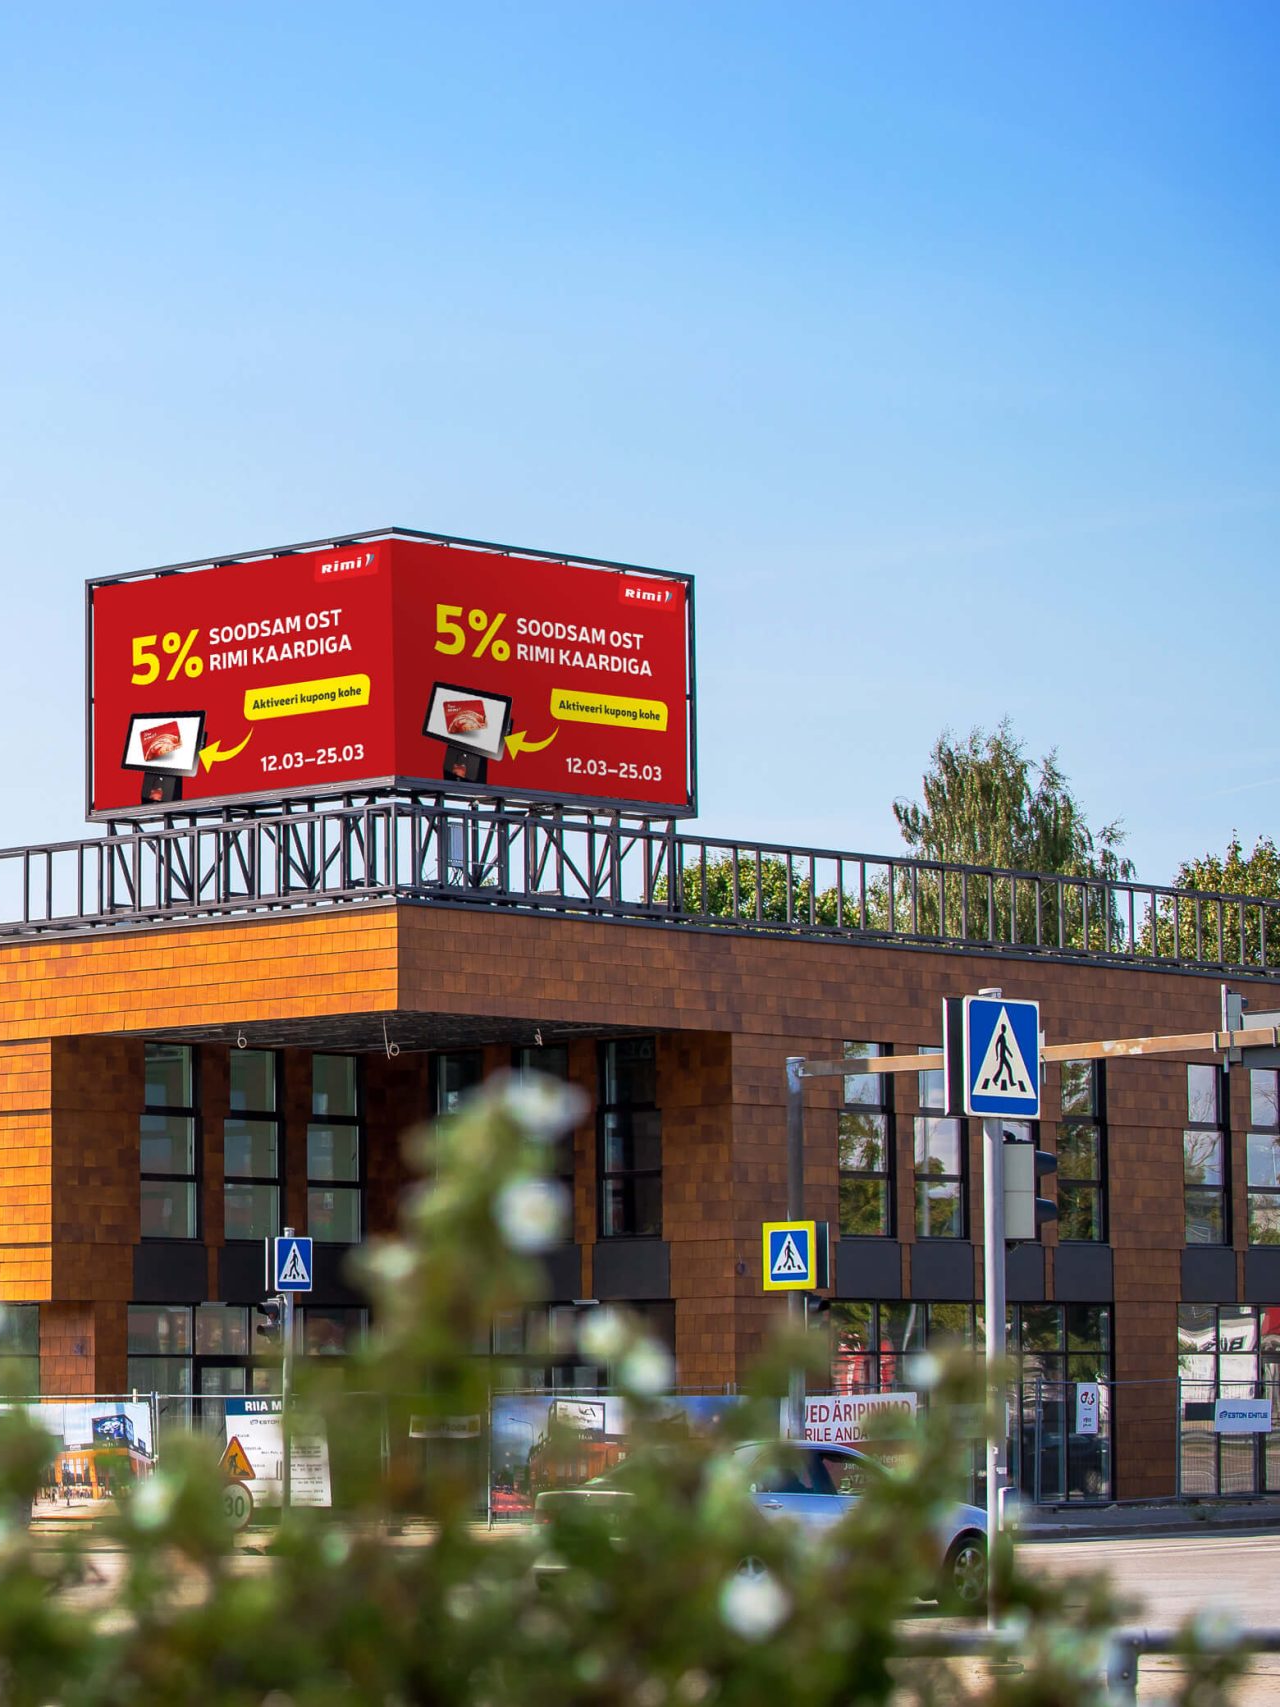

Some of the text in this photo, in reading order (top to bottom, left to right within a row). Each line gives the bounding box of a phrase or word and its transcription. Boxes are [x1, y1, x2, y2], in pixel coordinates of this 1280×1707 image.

[322, 556, 362, 574] Rimi
[625, 588, 662, 602] Rimi
[209, 608, 342, 645] SOODSAM OST
[434, 603, 511, 662] 5%
[516, 617, 644, 650] SOODSAM OST
[131, 629, 204, 686] 5%
[209, 634, 352, 671] RIMI KAARDIGA
[516, 643, 652, 677] RIMI KAARDIGA
[252, 686, 362, 711] Aktiveeri kupong kohe
[558, 699, 661, 721] Aktiveeri kupong kohe
[245, 1401, 268, 1412] RIIA
[224, 1495, 245, 1518] 30
